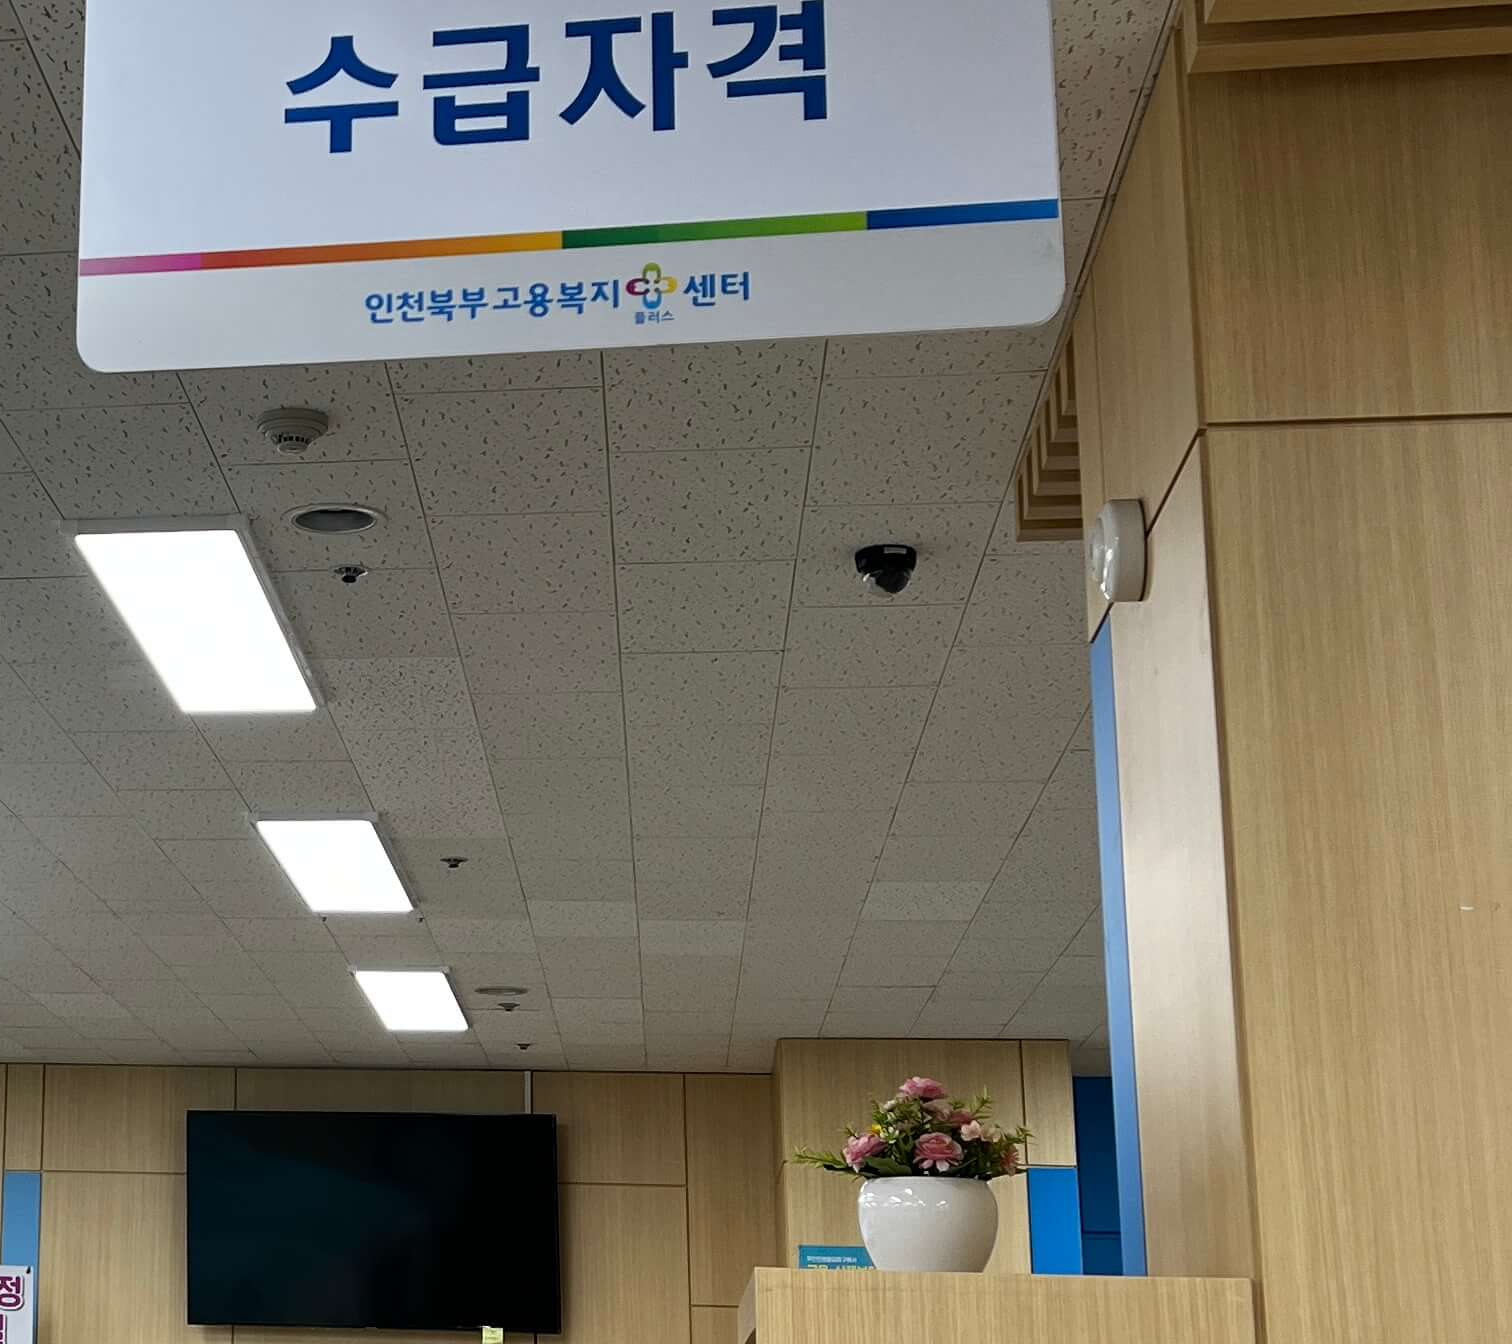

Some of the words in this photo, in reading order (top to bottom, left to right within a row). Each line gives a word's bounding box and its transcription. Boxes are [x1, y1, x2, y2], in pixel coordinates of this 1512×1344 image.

[283, 0, 827, 154] 수급자격
[364, 278, 620, 324] 인천북부고용복지
[683, 271, 751, 307] 센터
[634, 309, 675, 324] 플러스
